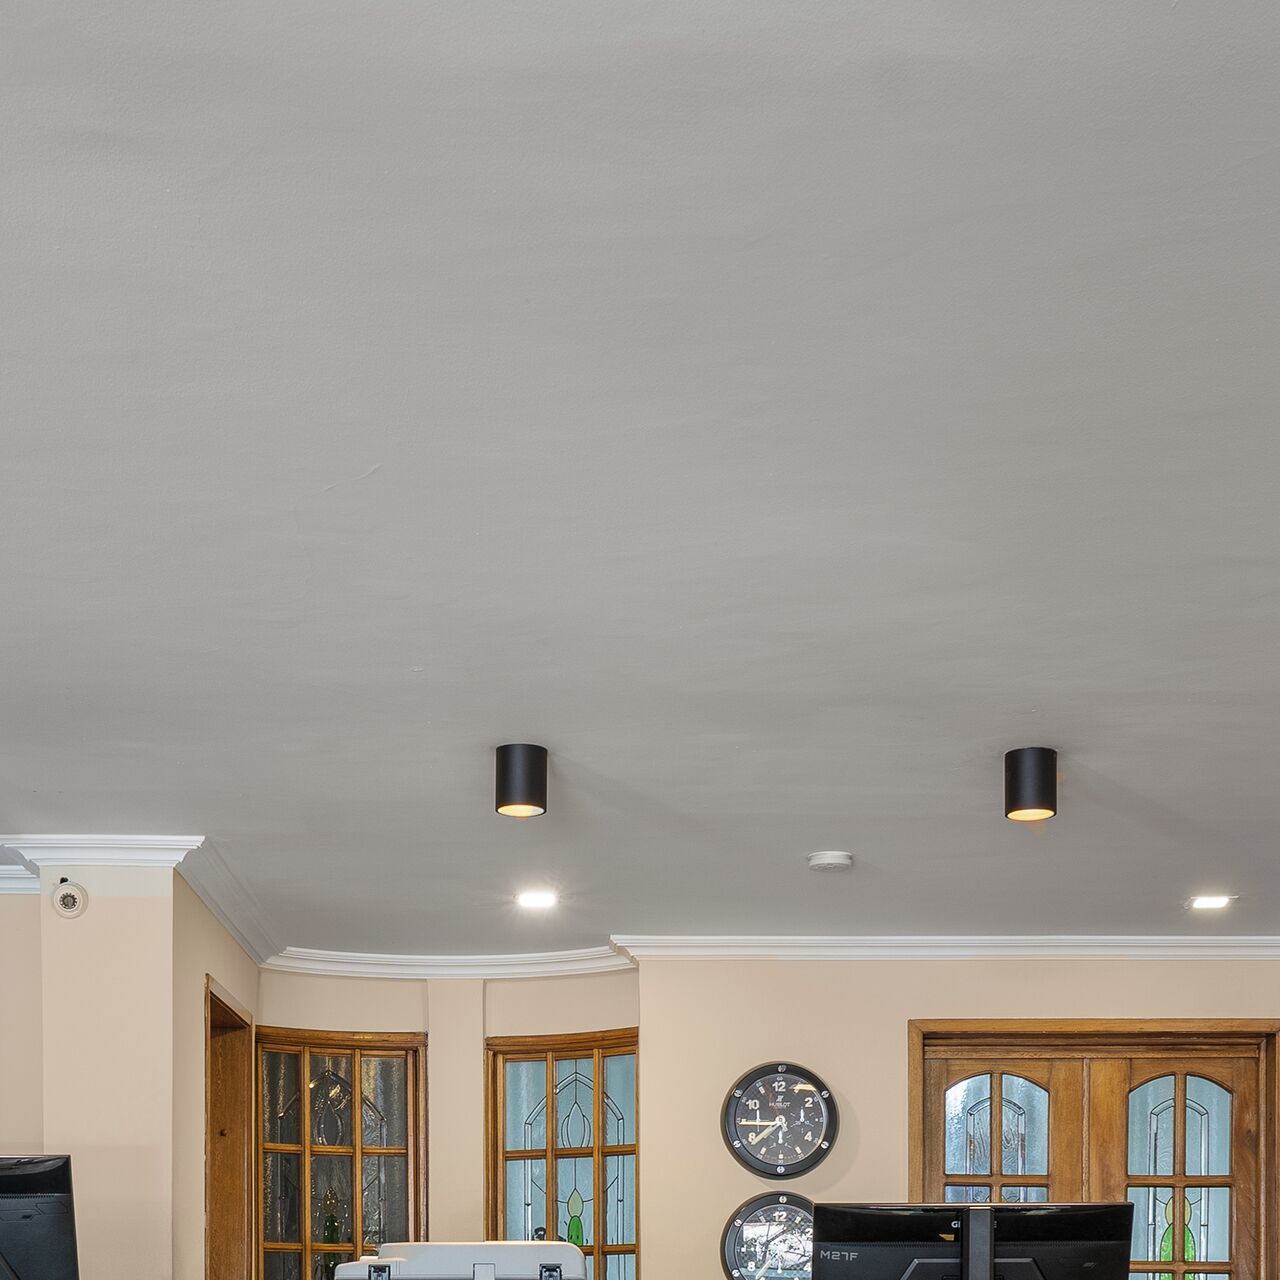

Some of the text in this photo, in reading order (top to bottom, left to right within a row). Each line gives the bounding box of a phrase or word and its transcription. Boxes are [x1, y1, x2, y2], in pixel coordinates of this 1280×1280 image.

[772, 1081, 786, 1092] 12
[746, 1099, 759, 1110] 10
[804, 1097, 813, 1107] 2
[748, 1132, 756, 1142] 8
[804, 1131, 813, 1142] 4
[773, 1211, 787, 1222] 12
[805, 1228, 813, 1238] 2
[820, 1250, 859, 1261] M27F
[747, 1261, 756, 1272] 8
[803, 1263, 812, 1273] 4
